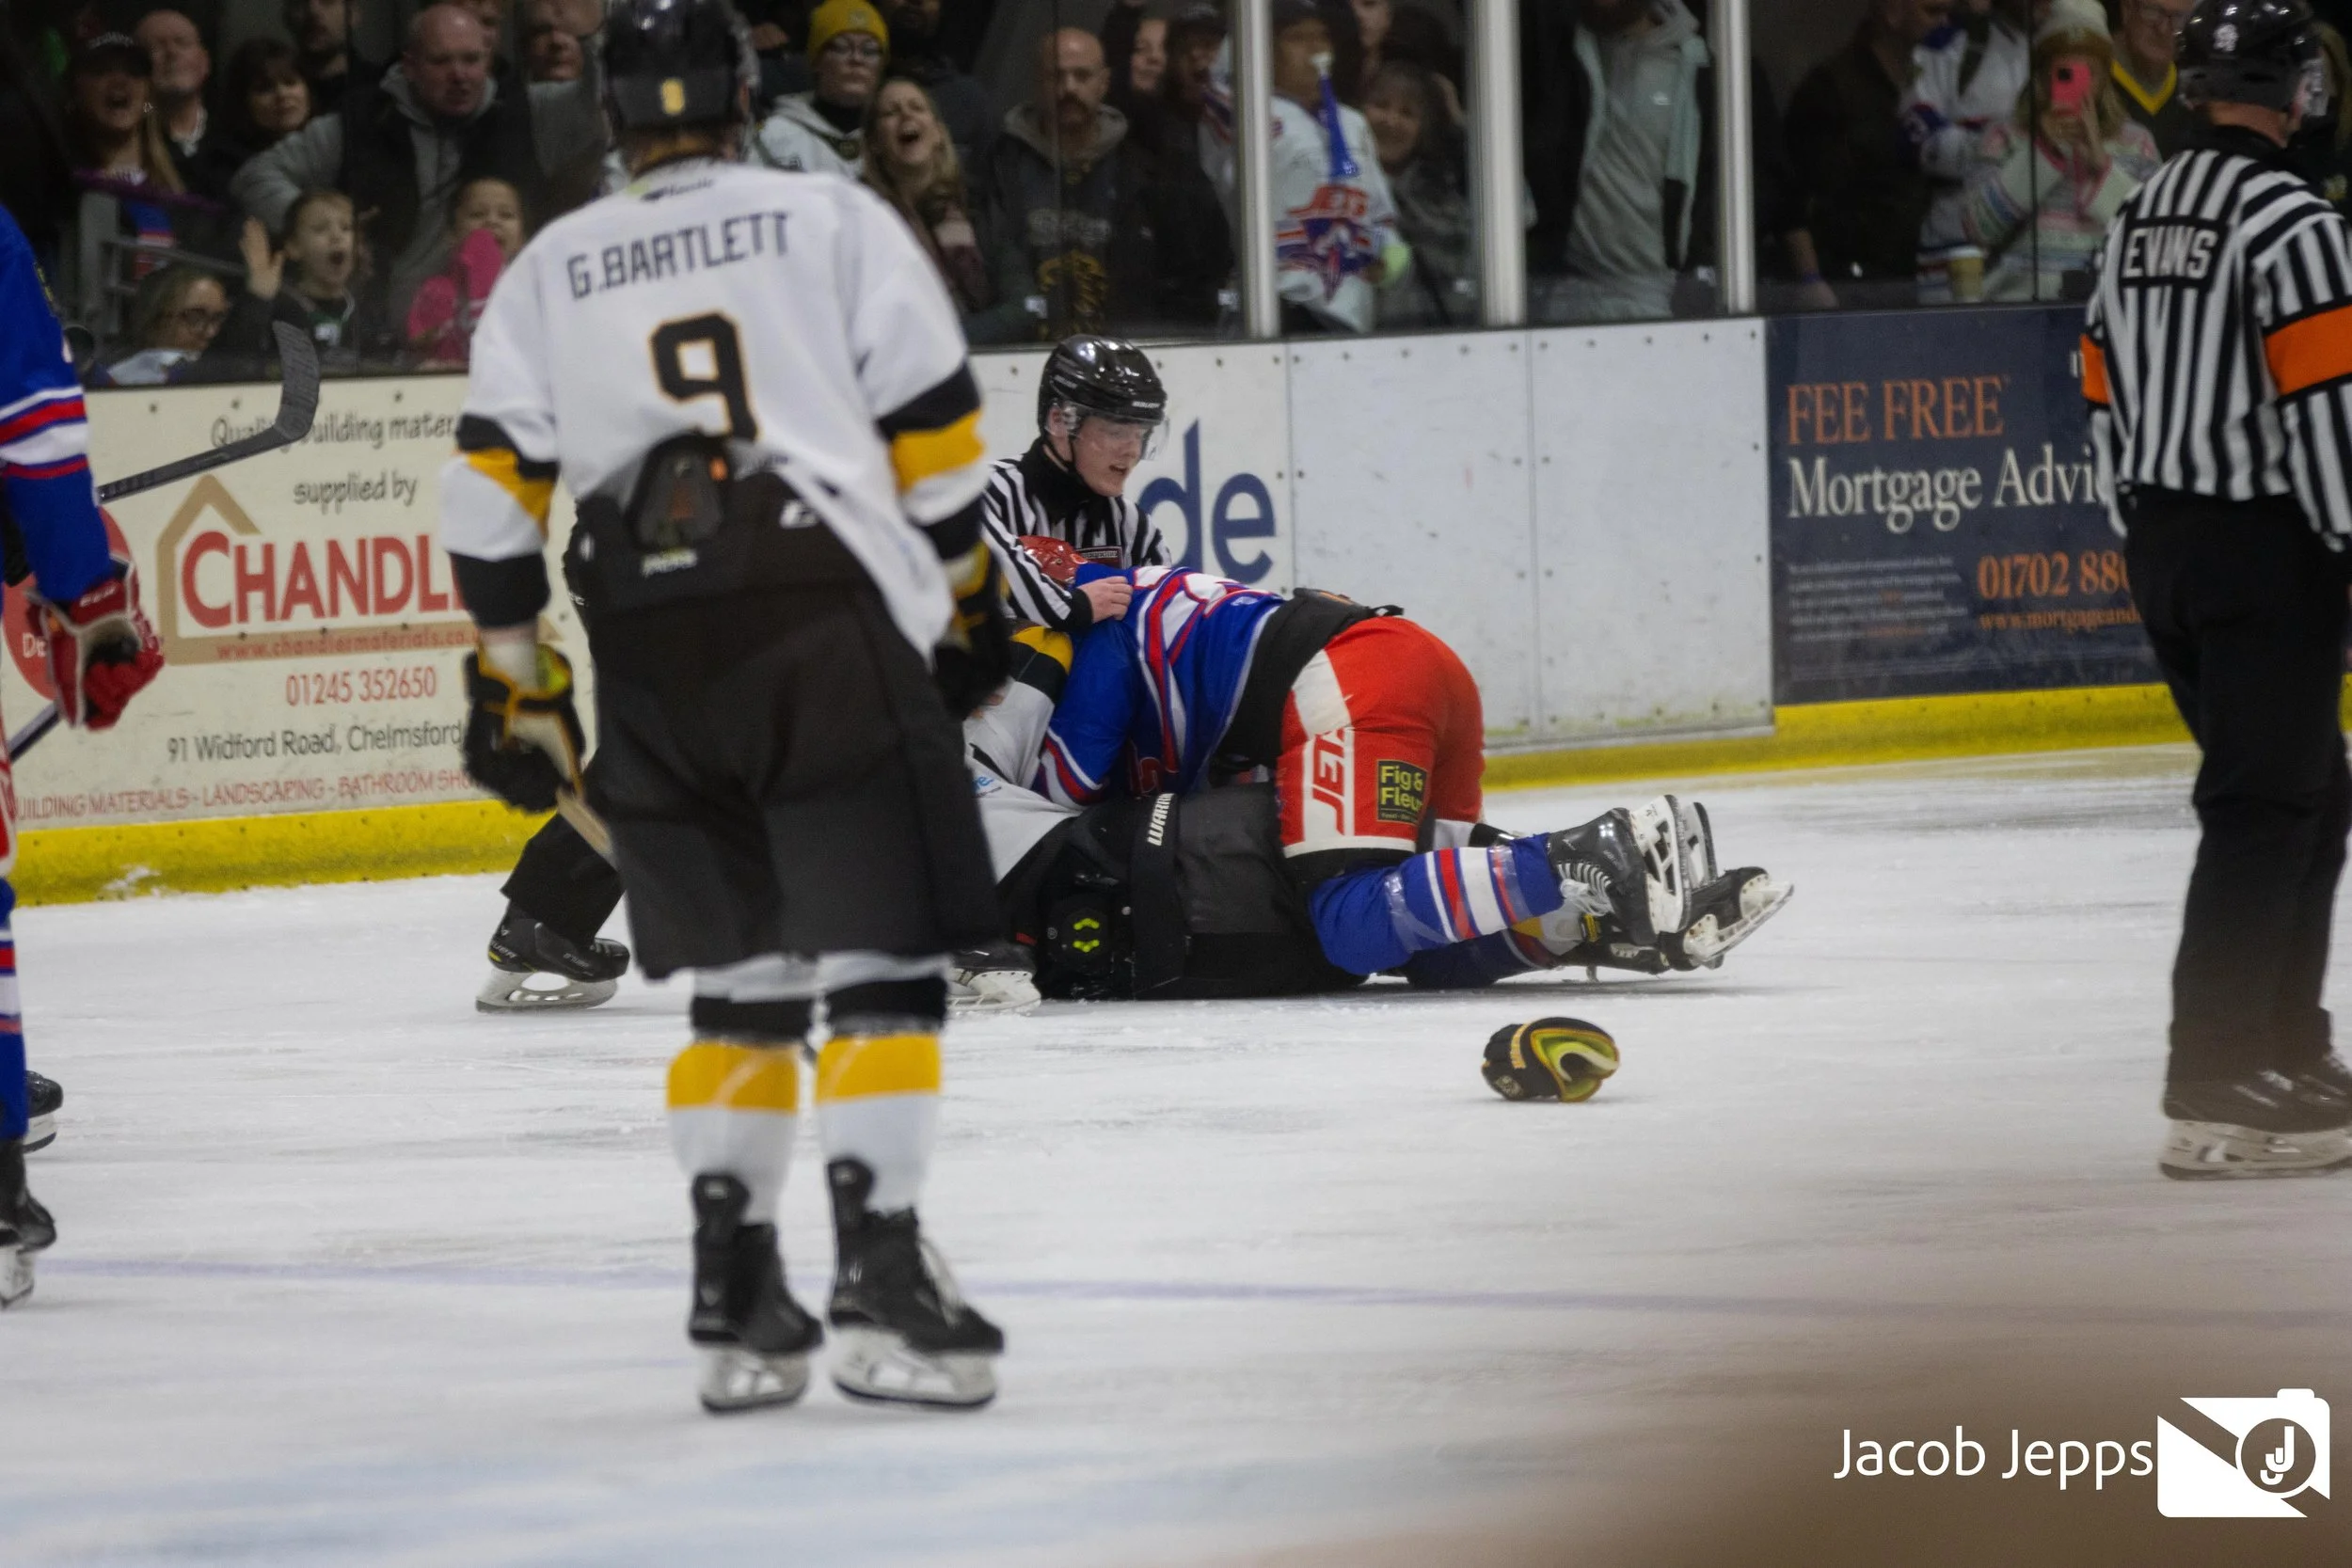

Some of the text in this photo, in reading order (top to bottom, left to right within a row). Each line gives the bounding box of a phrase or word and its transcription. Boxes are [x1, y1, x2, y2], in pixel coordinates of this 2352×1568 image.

[566, 210, 789, 300] G.BARTLETT
[2122, 226, 2218, 279] EVANS
[649, 309, 763, 448] 9
[1788, 381, 1871, 445] FEE
[294, 471, 418, 514] supplied by
[1788, 455, 1983, 534] Mortgage
[1978, 550, 2070, 599] 01702
[285, 665, 437, 706] 01245 352650
[167, 720, 464, 763] 91 Widford Road, Chelmsford
[16, 795, 84, 821] UILDING
[88, 787, 189, 816] MATERIALS
[201, 777, 325, 808] LANDSCAPING
[337, 770, 433, 799] BATHROOM
[1380, 764, 1423, 791] Fig &
